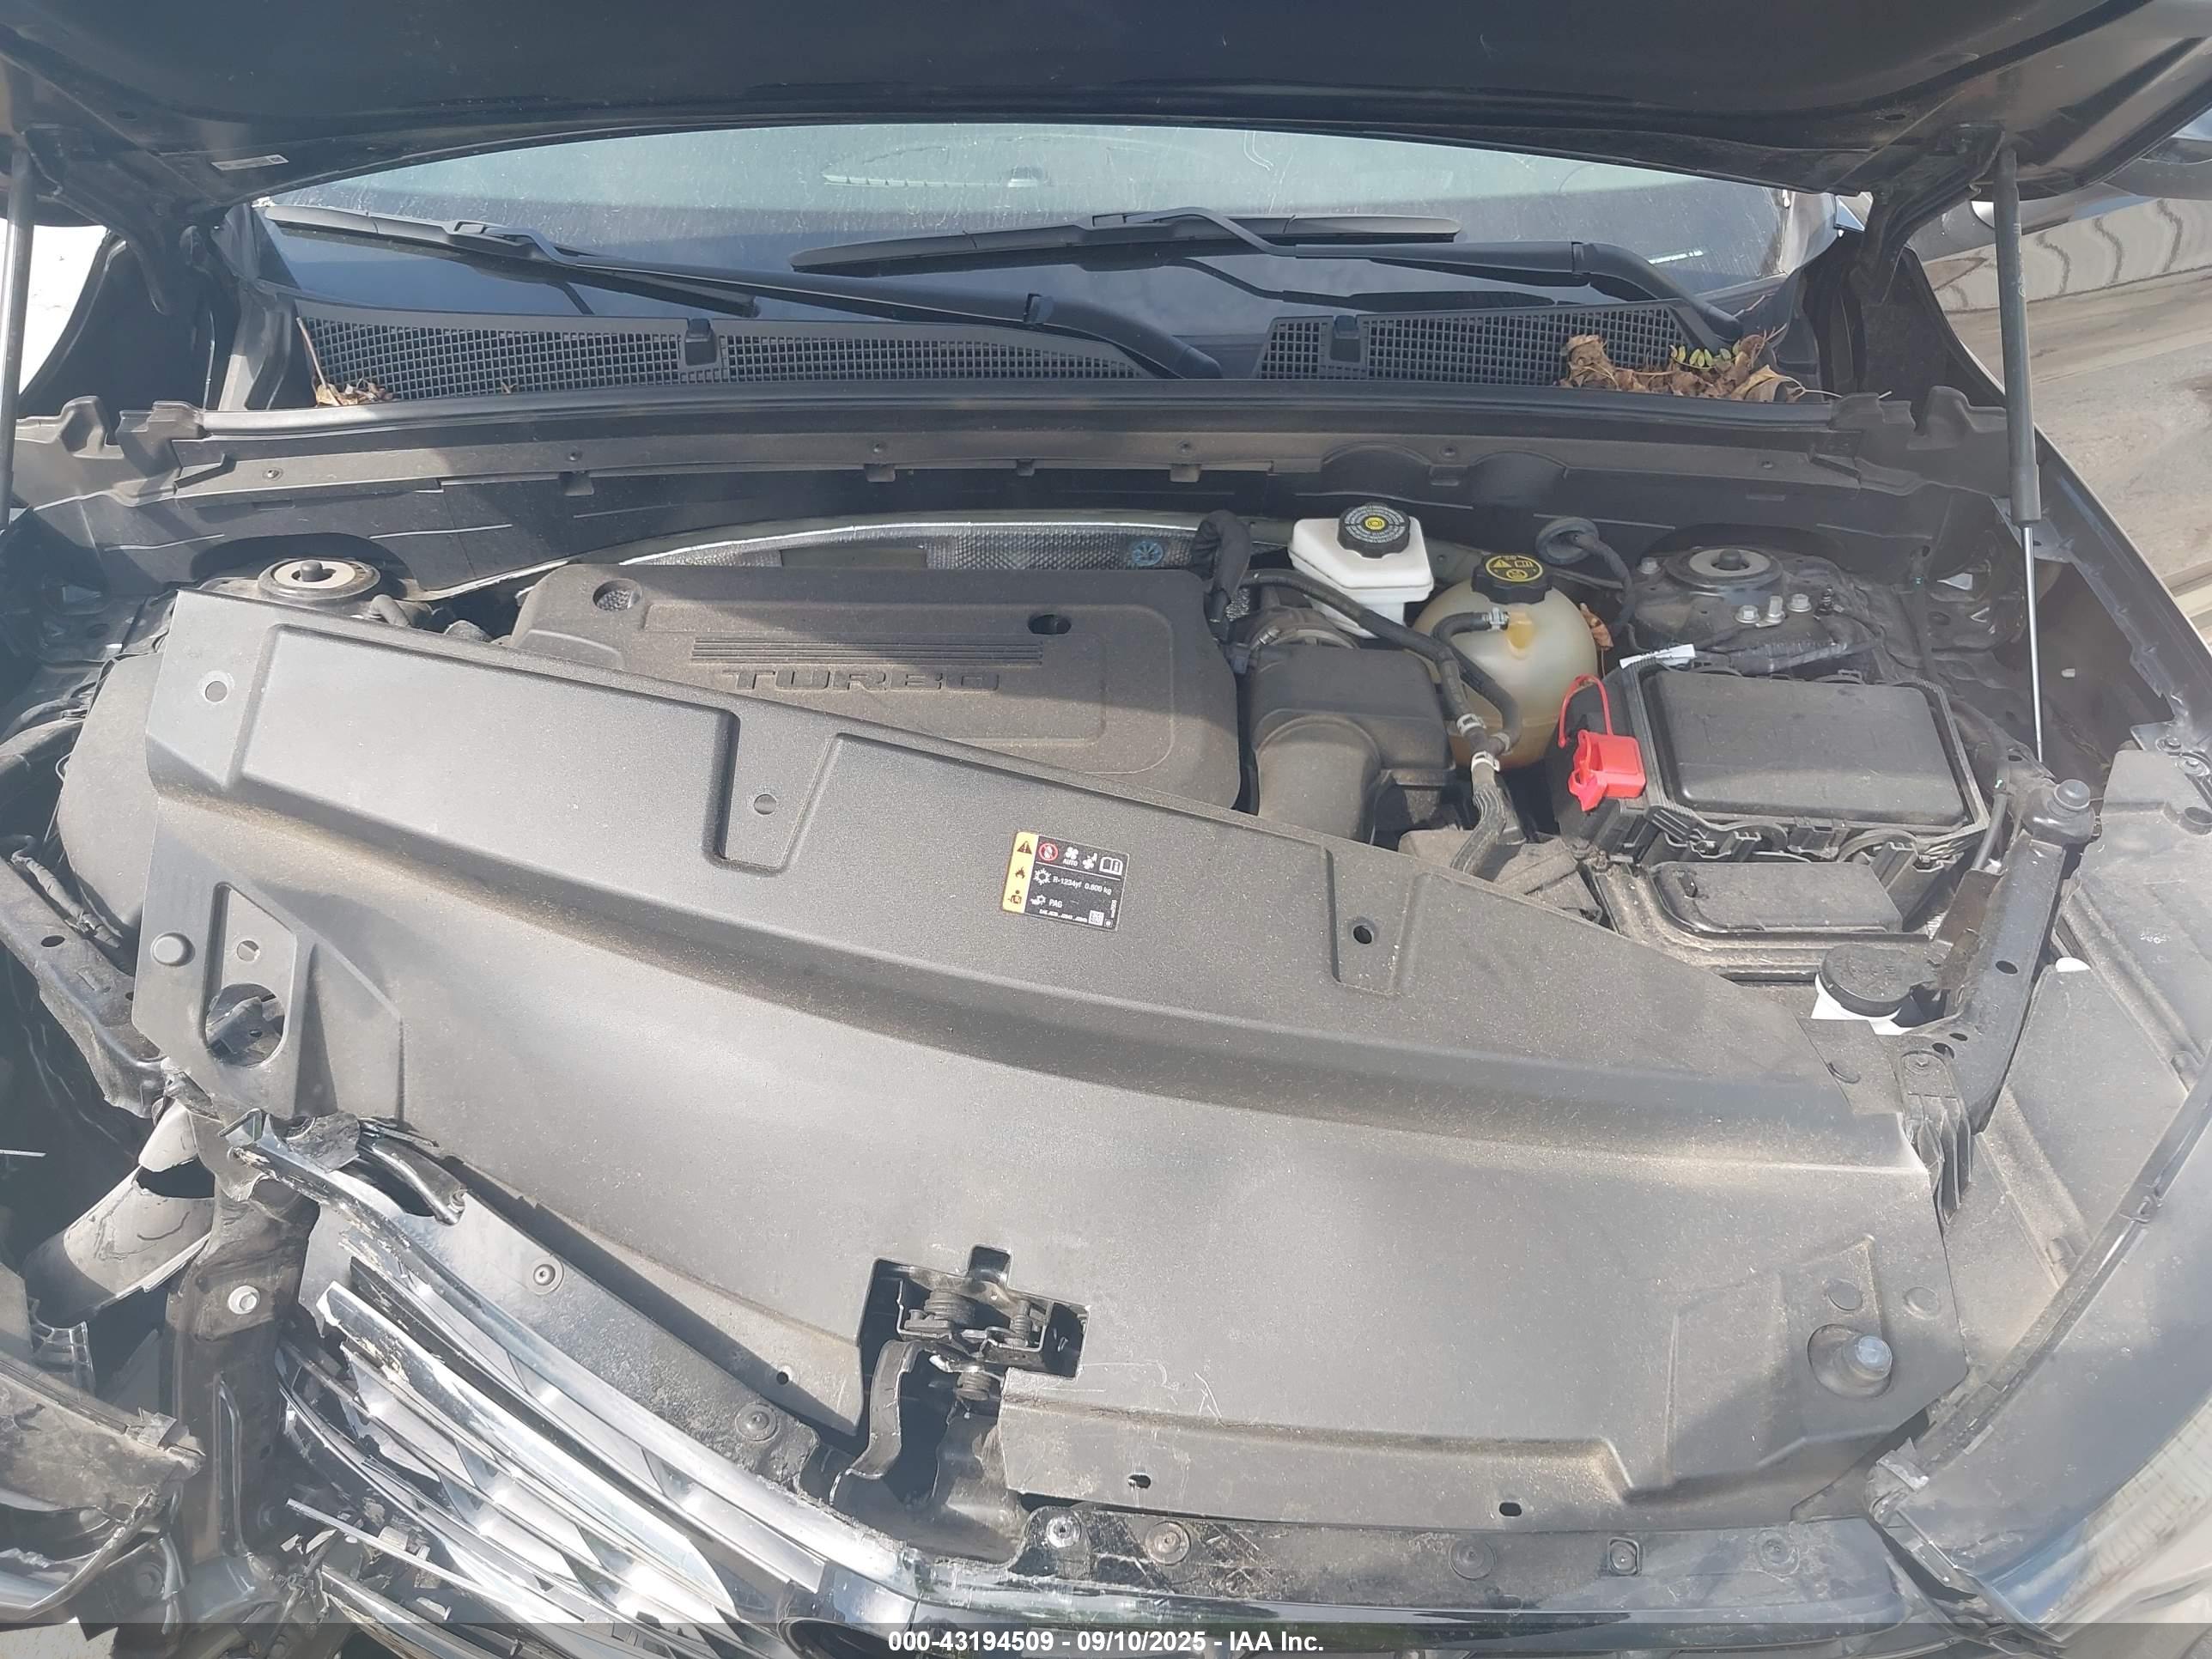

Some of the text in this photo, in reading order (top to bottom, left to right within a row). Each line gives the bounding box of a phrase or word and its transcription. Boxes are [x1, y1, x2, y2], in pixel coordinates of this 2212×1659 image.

[723, 670, 1000, 692] TURBO
[1103, 885, 1112, 896] kg
[1048, 898, 1063, 908] PAG
